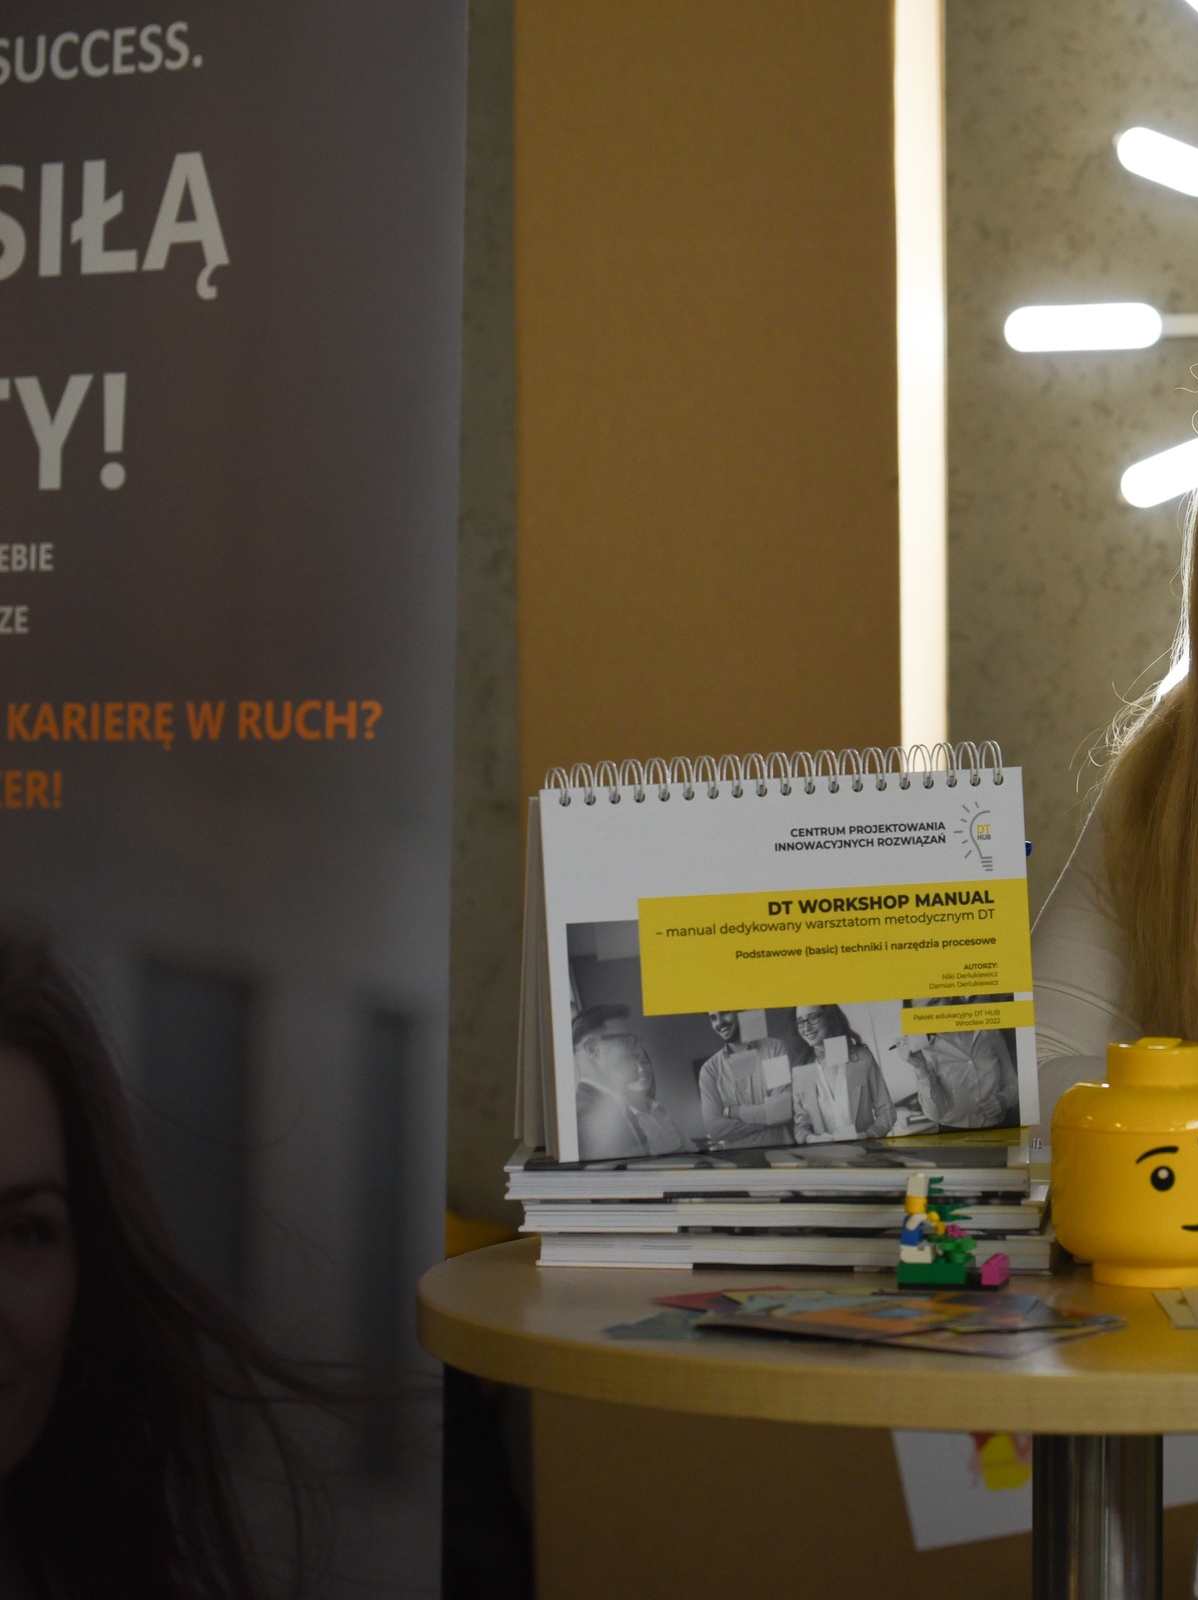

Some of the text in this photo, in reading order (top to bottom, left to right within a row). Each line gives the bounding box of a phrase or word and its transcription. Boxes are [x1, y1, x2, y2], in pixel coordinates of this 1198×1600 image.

[0, 371, 127, 491] Y!
[7, 699, 383, 751] KARIERĘ W RUCH?
[0, 769, 63, 810] ER!
[790, 821, 946, 838] CENTRUM PROJEKTOWANIA
[976, 823, 991, 834] DT
[976, 833, 992, 841] HUB
[774, 833, 947, 852] INNOWACYJNYCH ROZWIĄZAŃ
[768, 890, 995, 916] DT WORKSHOP MANUAL
[666, 924, 716, 937] manual
[719, 921, 802, 935] dedykowany
[805, 914, 881, 929] warsztatom
[884, 911, 975, 926] metodycznym
[978, 908, 996, 920] DT
[735, 936, 997, 959] Podstawowe (basic) techniki i narzędzia procesowe
[963, 962, 998, 971] AUTORZY:
[928, 981, 955, 990] Damian
[913, 1009, 1001, 1021] Pakiet edukacyjny DT HUB
[985, 1017, 1001, 1026] 2022
